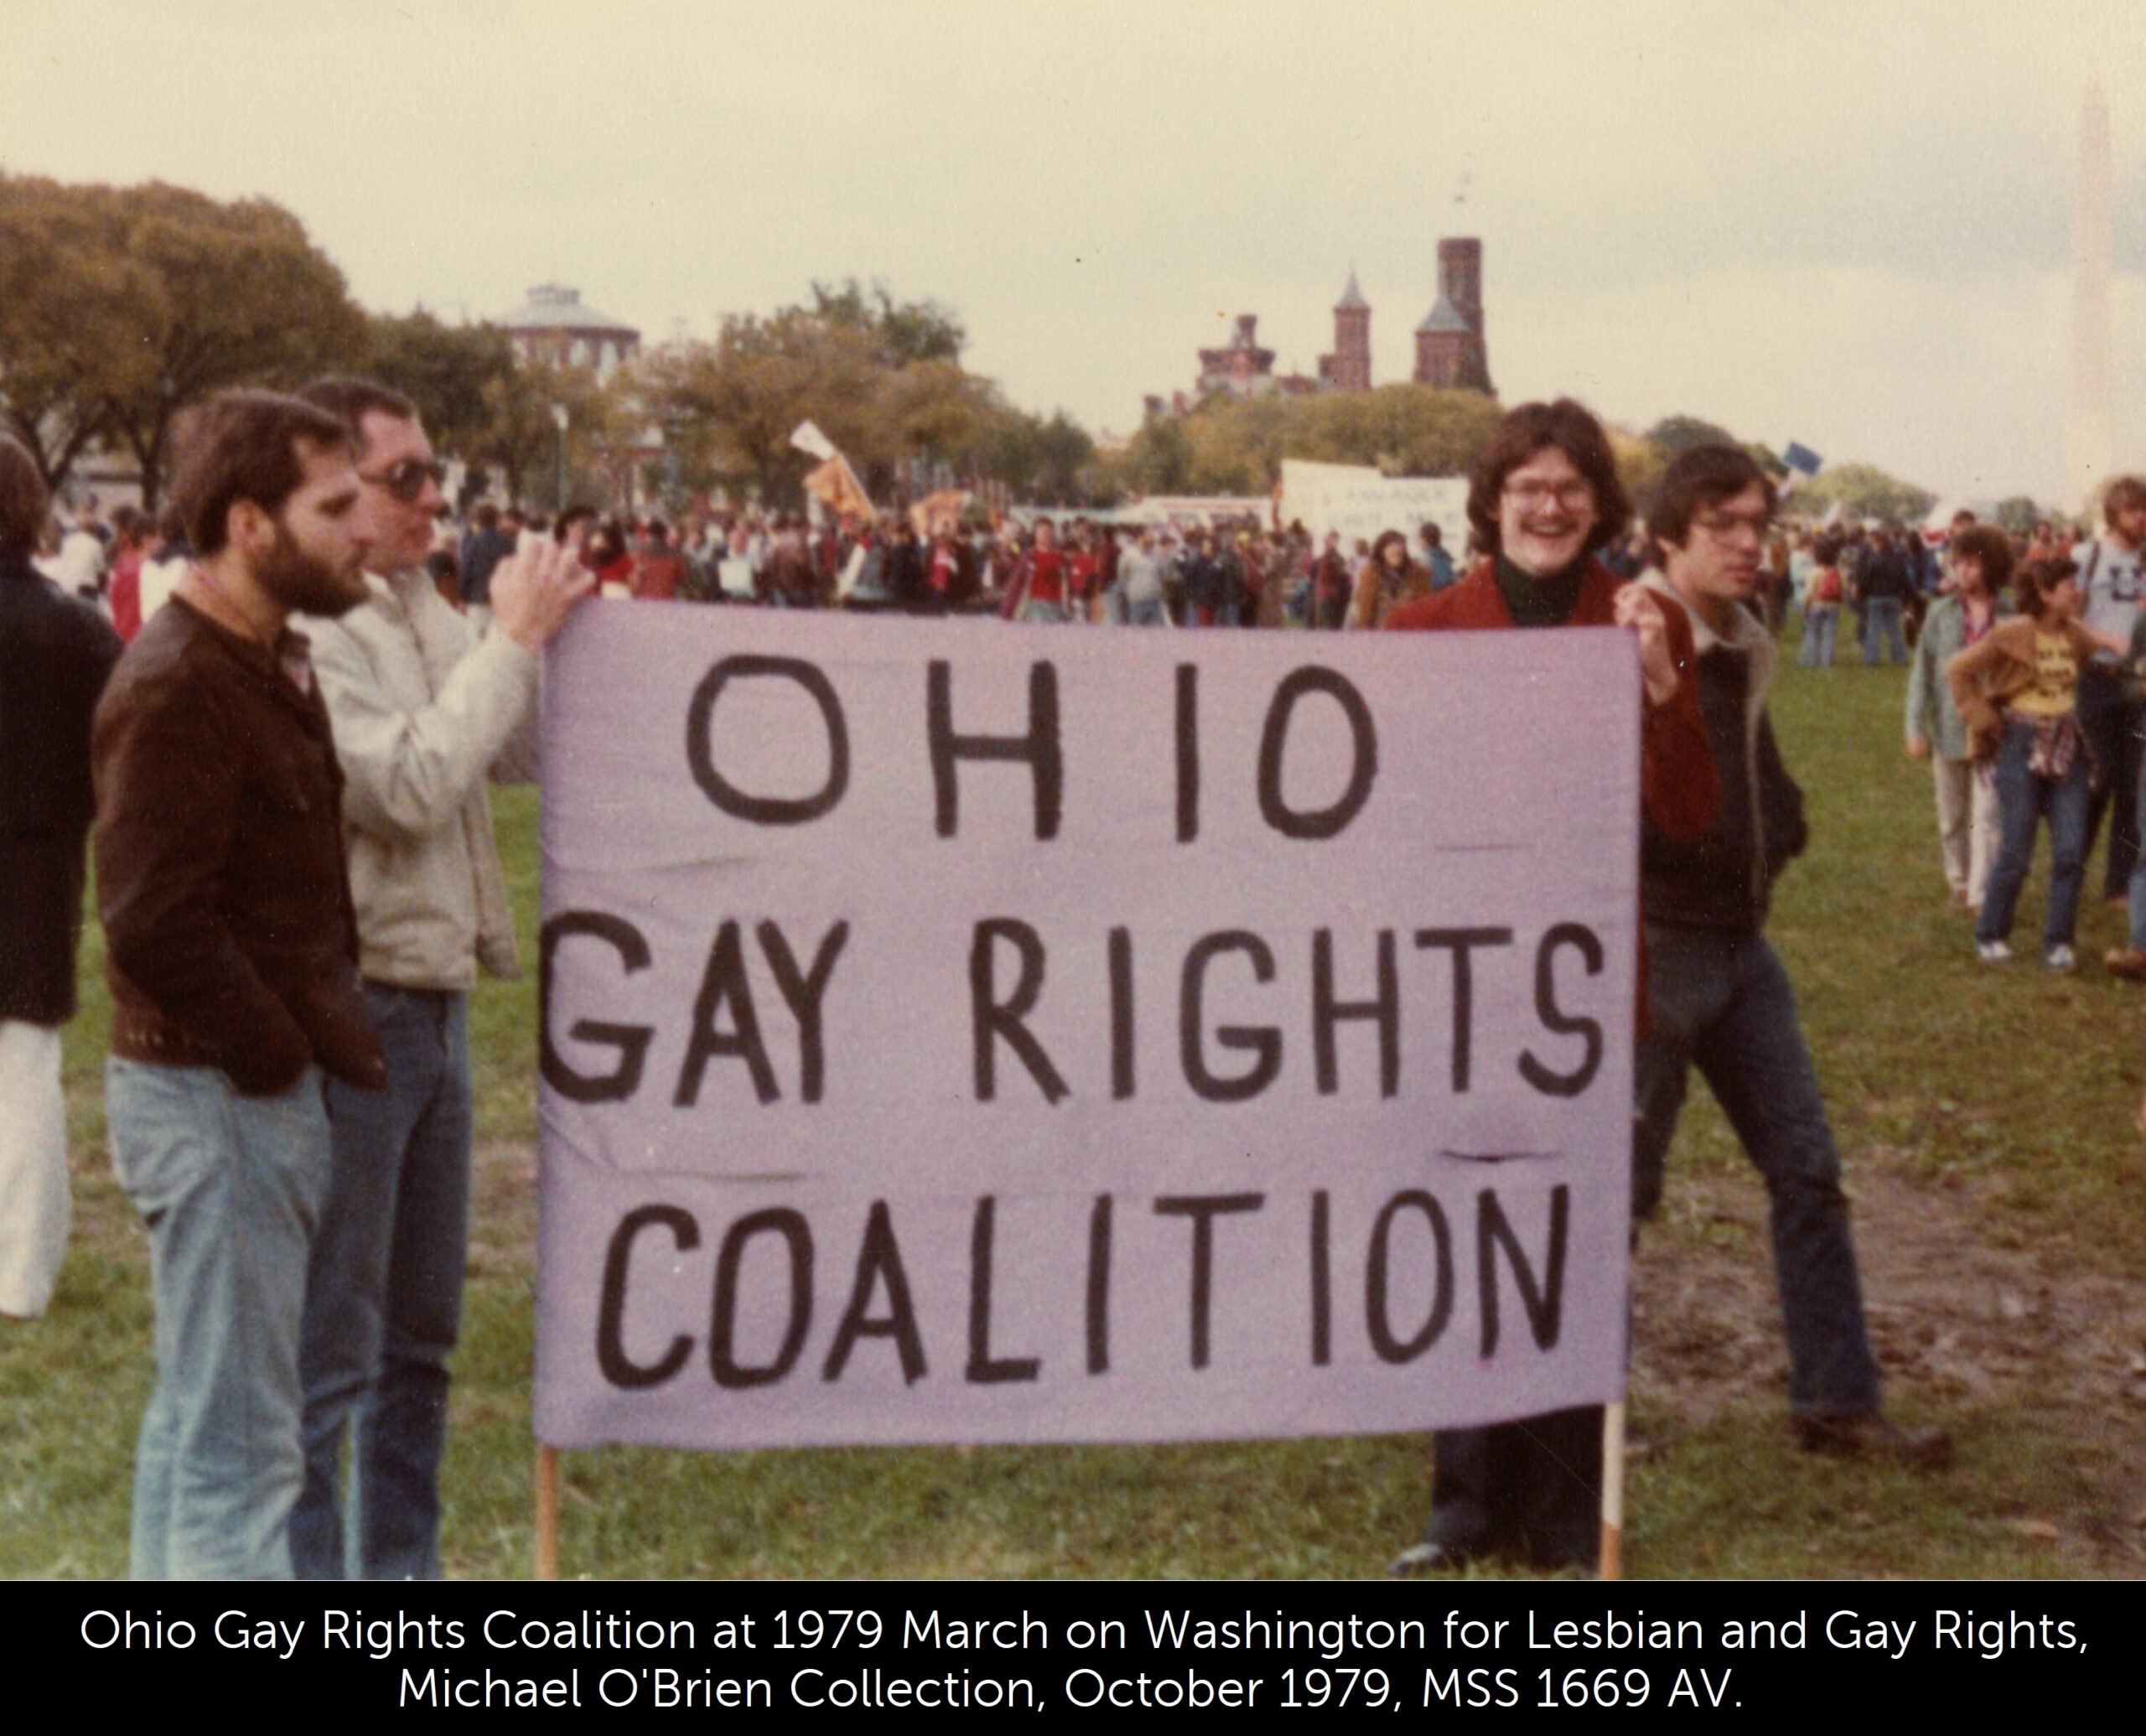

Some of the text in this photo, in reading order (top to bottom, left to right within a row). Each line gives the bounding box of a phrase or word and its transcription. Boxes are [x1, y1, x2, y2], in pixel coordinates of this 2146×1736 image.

[687, 655, 1377, 842] OHIO
[538, 909, 1604, 1106] GAY RIGHTS
[596, 1183, 1571, 1391] COALITION
